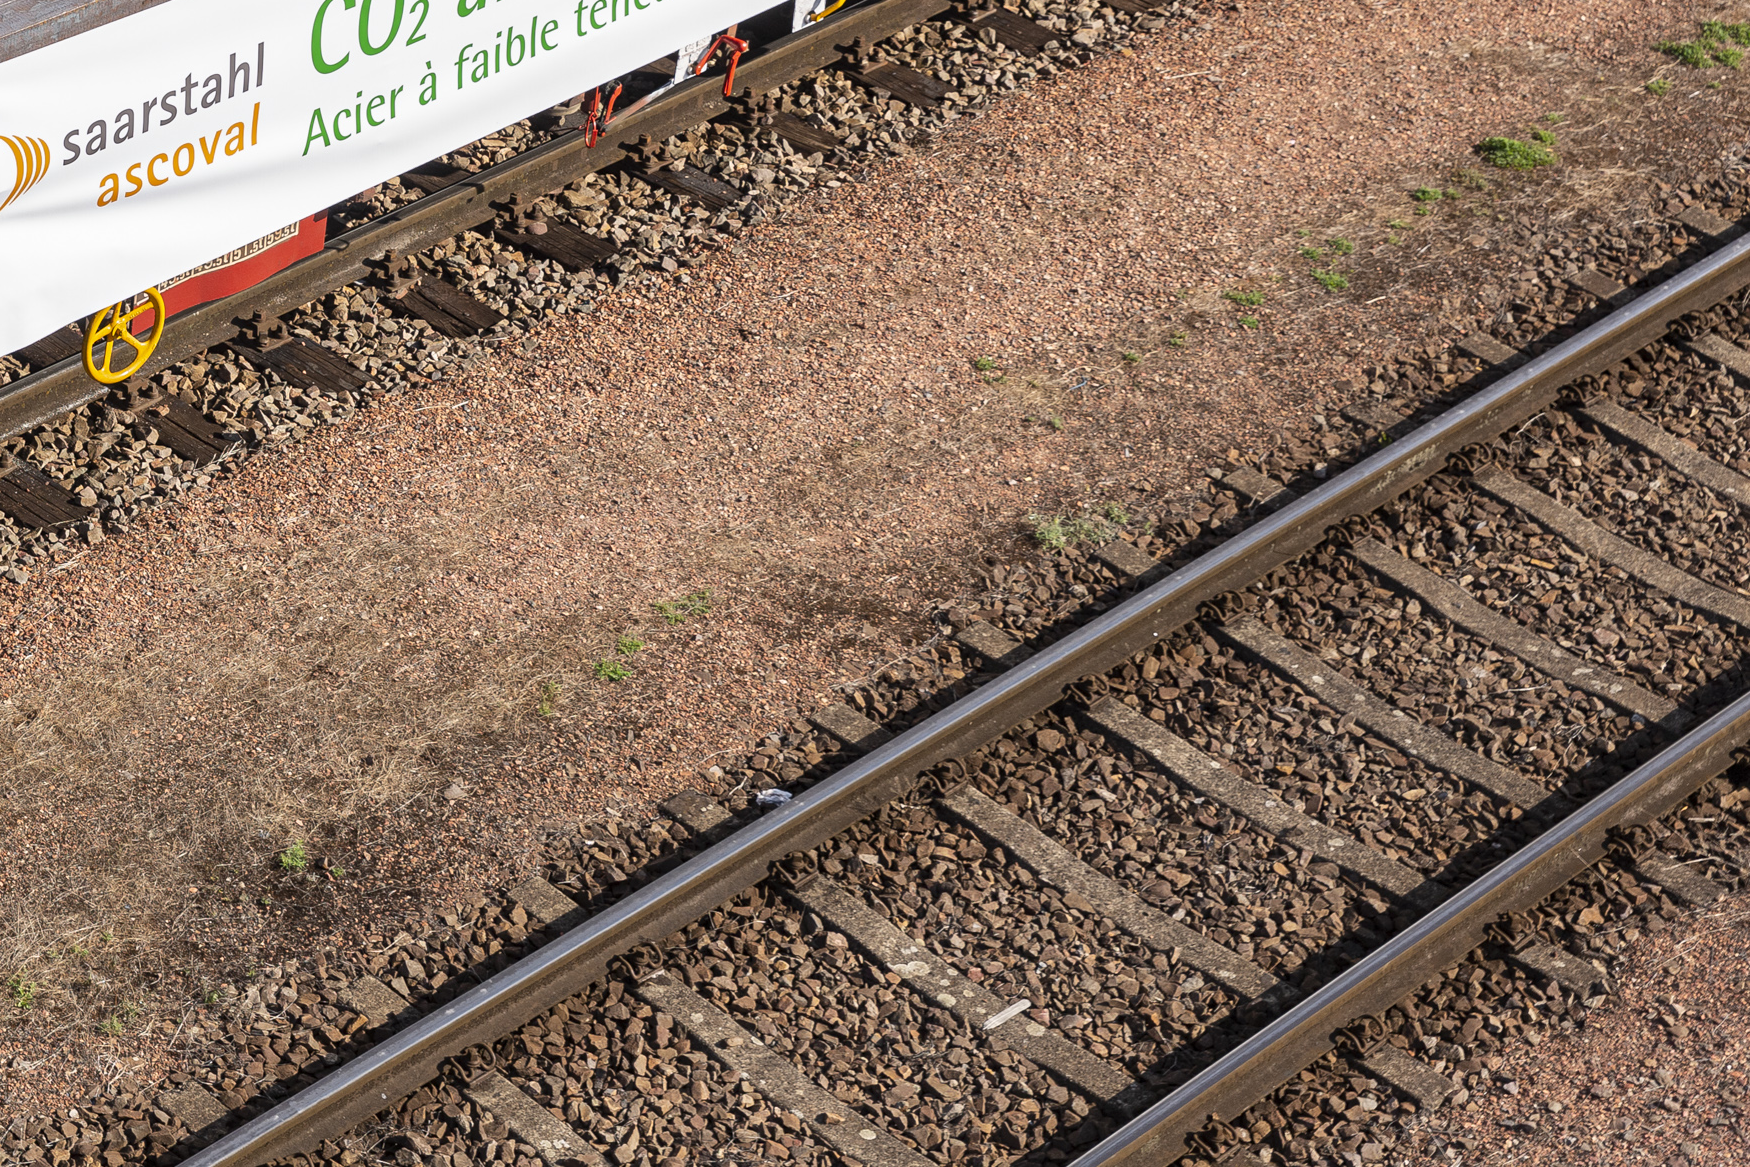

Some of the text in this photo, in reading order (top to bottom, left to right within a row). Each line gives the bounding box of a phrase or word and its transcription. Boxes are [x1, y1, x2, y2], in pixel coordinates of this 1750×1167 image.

[62, 41, 265, 167] saarstahl
[302, 85, 406, 158] Acier
[418, 61, 438, 107] à
[454, 15, 559, 90] faible
[96, 101, 260, 209] ascoval
